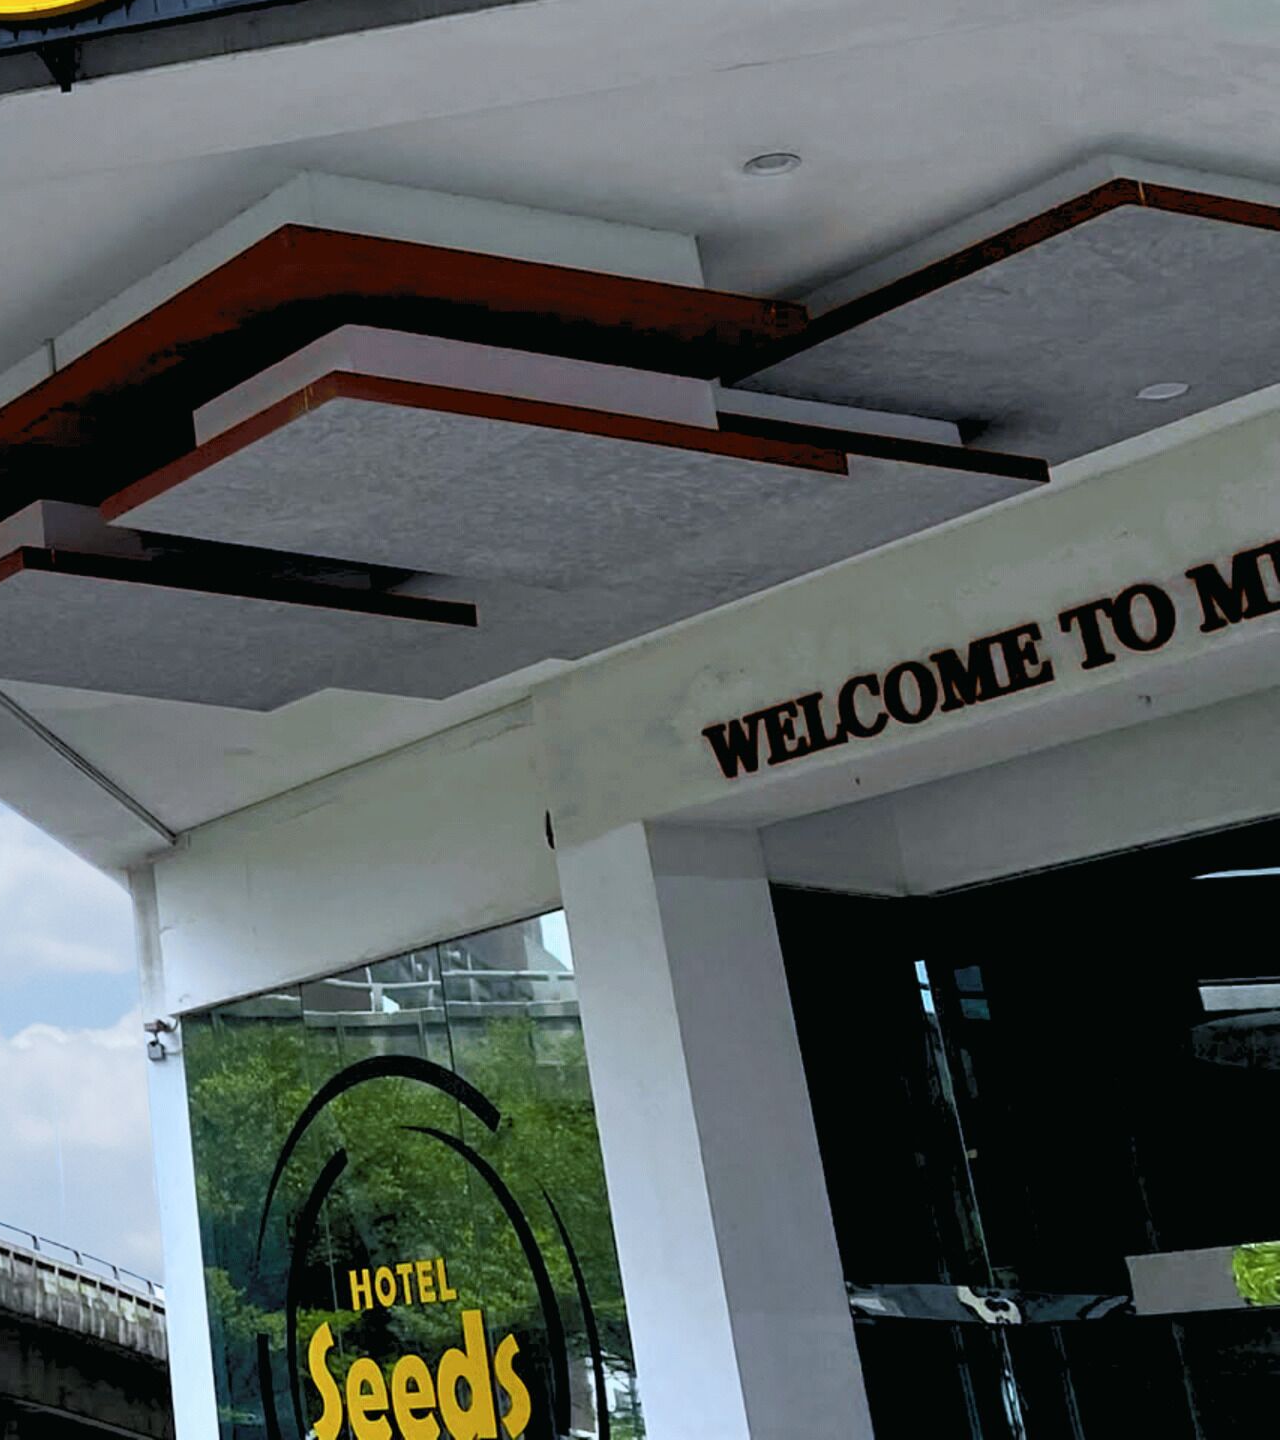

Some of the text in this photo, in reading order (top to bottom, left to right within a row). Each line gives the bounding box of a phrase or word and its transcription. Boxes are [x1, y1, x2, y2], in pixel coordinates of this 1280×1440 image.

[701, 540, 1280, 779] WELCOME TO M
[348, 1257, 458, 1311] HOTEL
[307, 1309, 532, 1440] Seeds
